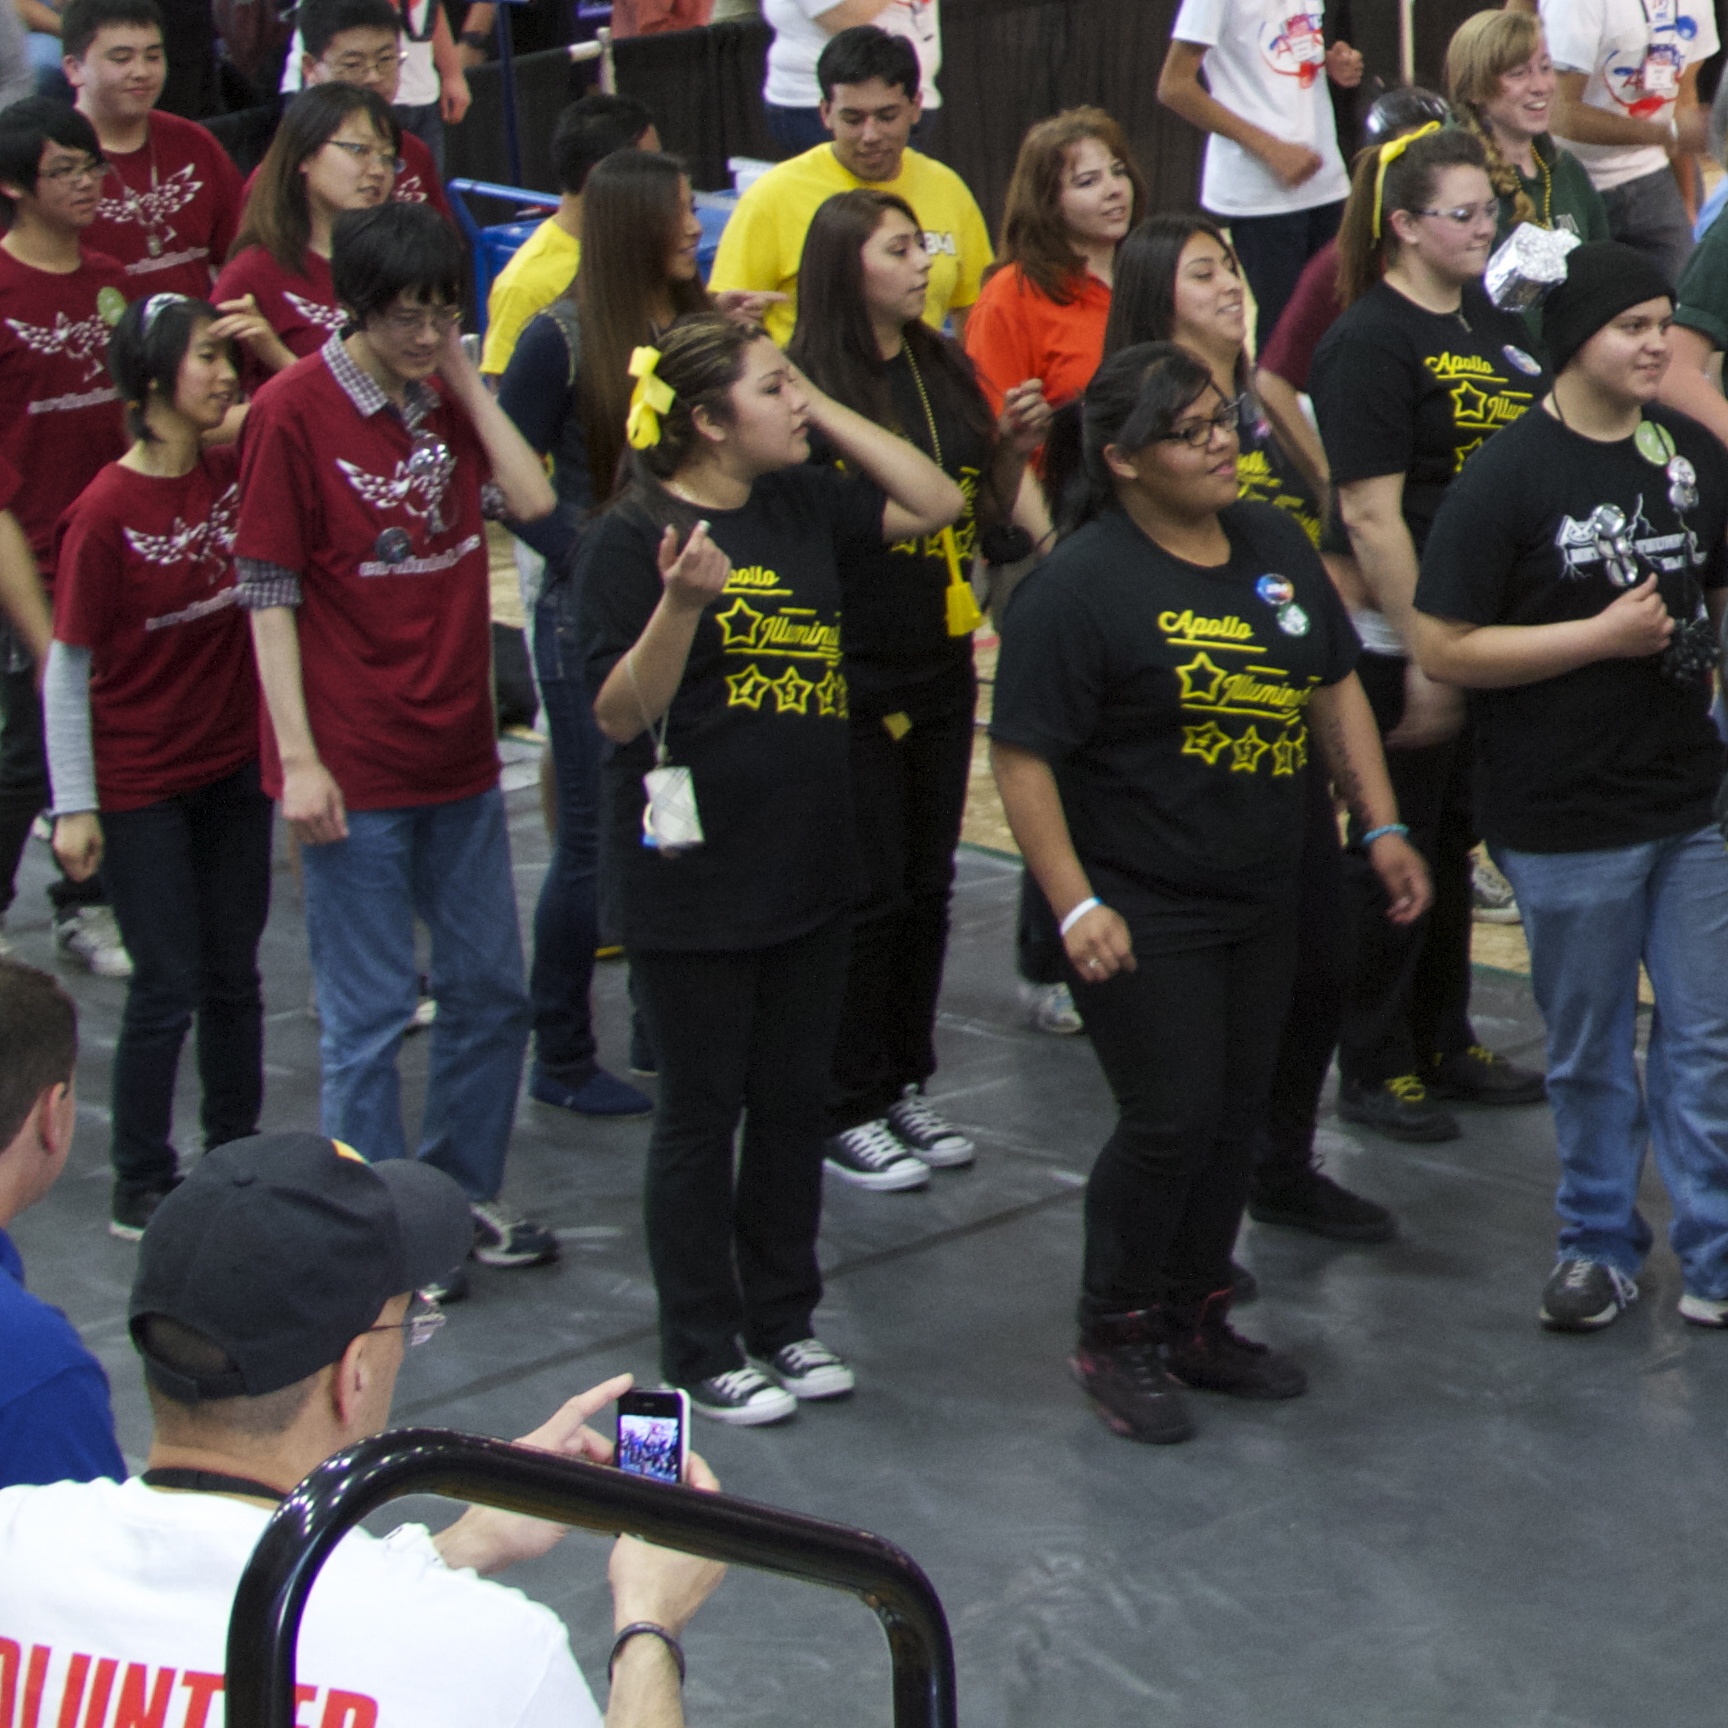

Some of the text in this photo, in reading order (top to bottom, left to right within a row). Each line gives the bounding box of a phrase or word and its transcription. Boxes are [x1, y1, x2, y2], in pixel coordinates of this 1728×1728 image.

[1425, 352, 1494, 375] Apollo
[728, 566, 780, 590] pollo
[1160, 609, 1255, 640] Apollo
